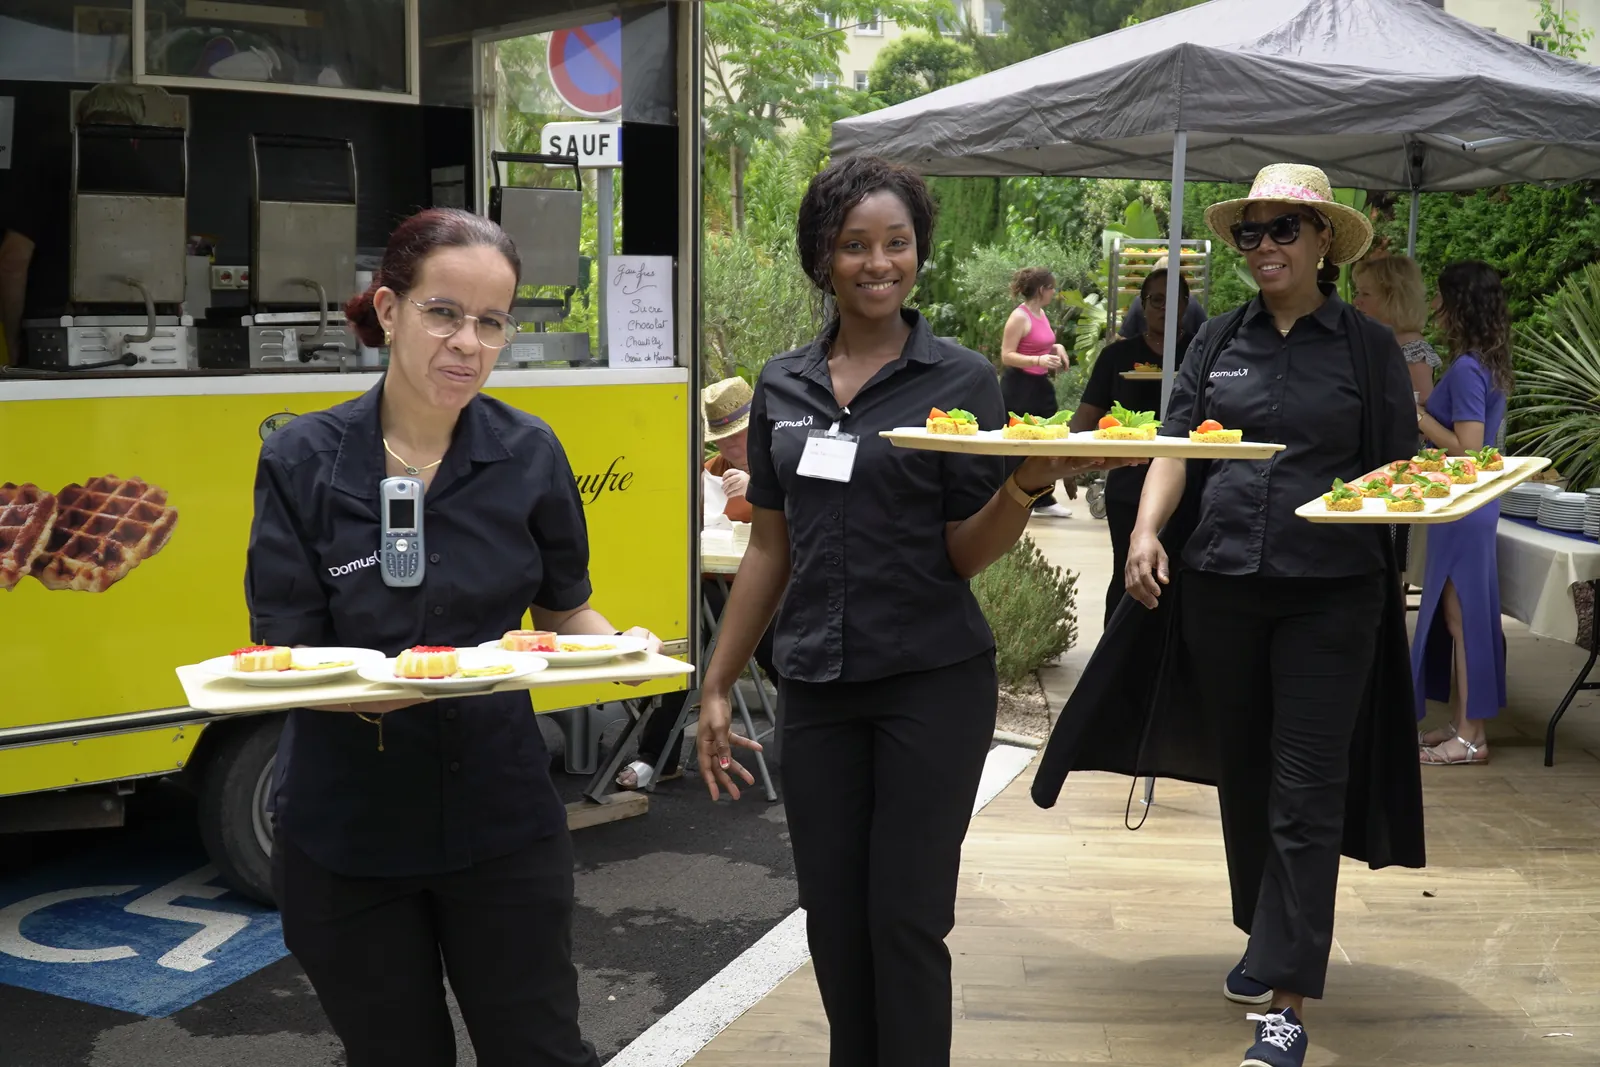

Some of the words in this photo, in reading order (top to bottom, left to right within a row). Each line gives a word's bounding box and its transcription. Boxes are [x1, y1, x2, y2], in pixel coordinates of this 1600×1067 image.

[549, 133, 611, 157] SAUF
[629, 298, 664, 314] Sucre
[627, 318, 668, 332] Chocolat
